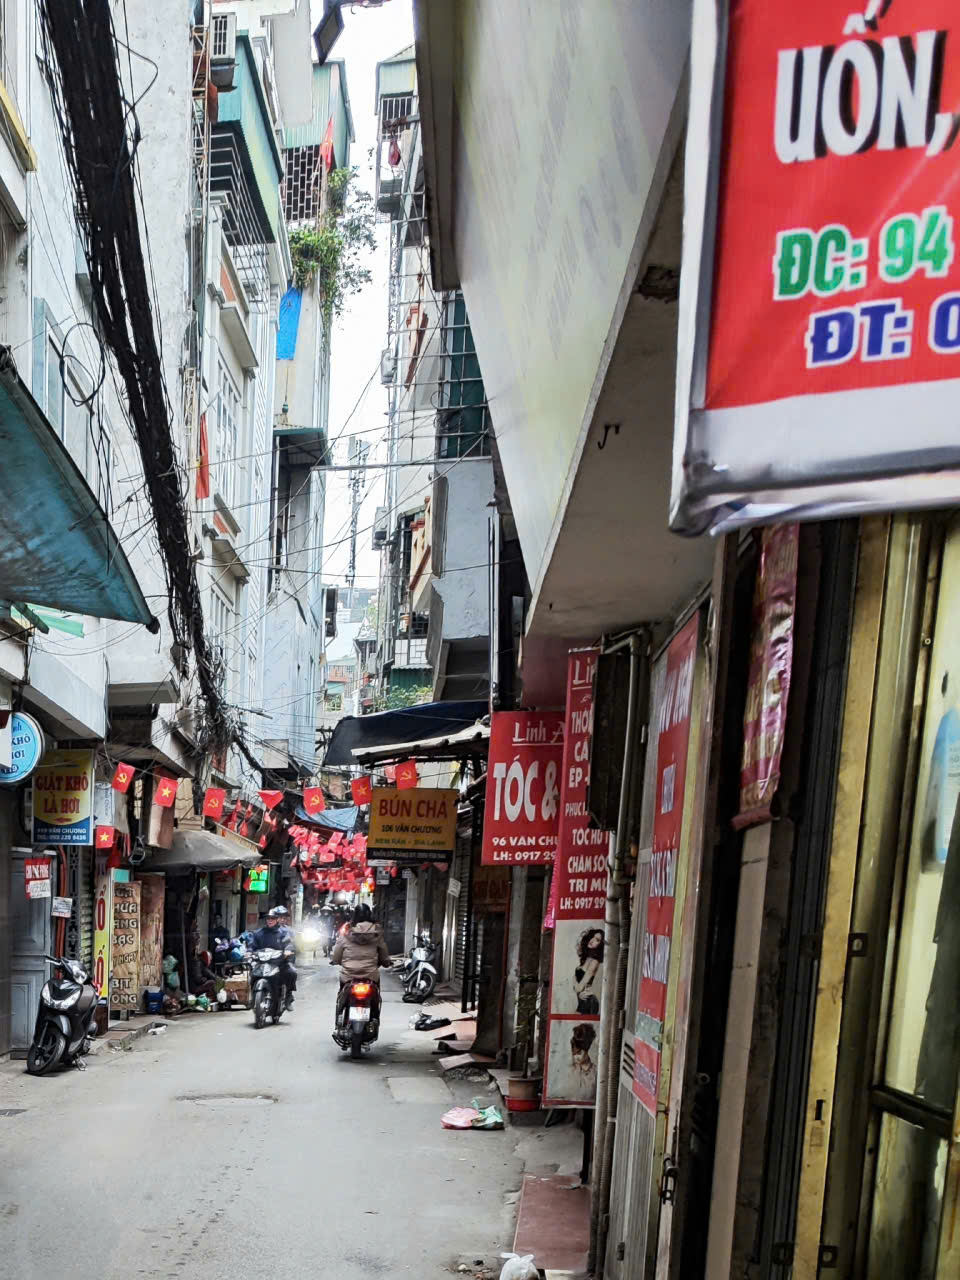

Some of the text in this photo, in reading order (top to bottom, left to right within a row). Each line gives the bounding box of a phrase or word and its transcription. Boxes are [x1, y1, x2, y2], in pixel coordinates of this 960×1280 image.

[773, 205, 954, 300] ĐC: 94
[804, 298, 914, 368] ĐT:
[512, 720, 547, 742] Linh
[65, 771, 89, 791] KHÔ
[493, 755, 539, 822] TÓC
[44, 791, 58, 813] LÀ
[378, 795, 412, 817] BÚN
[492, 836, 507, 846] 96
[493, 851, 512, 861] LH:
[515, 851, 541, 861] 0917
[560, 897, 574, 910] LH:
[575, 897, 592, 910] 0917
